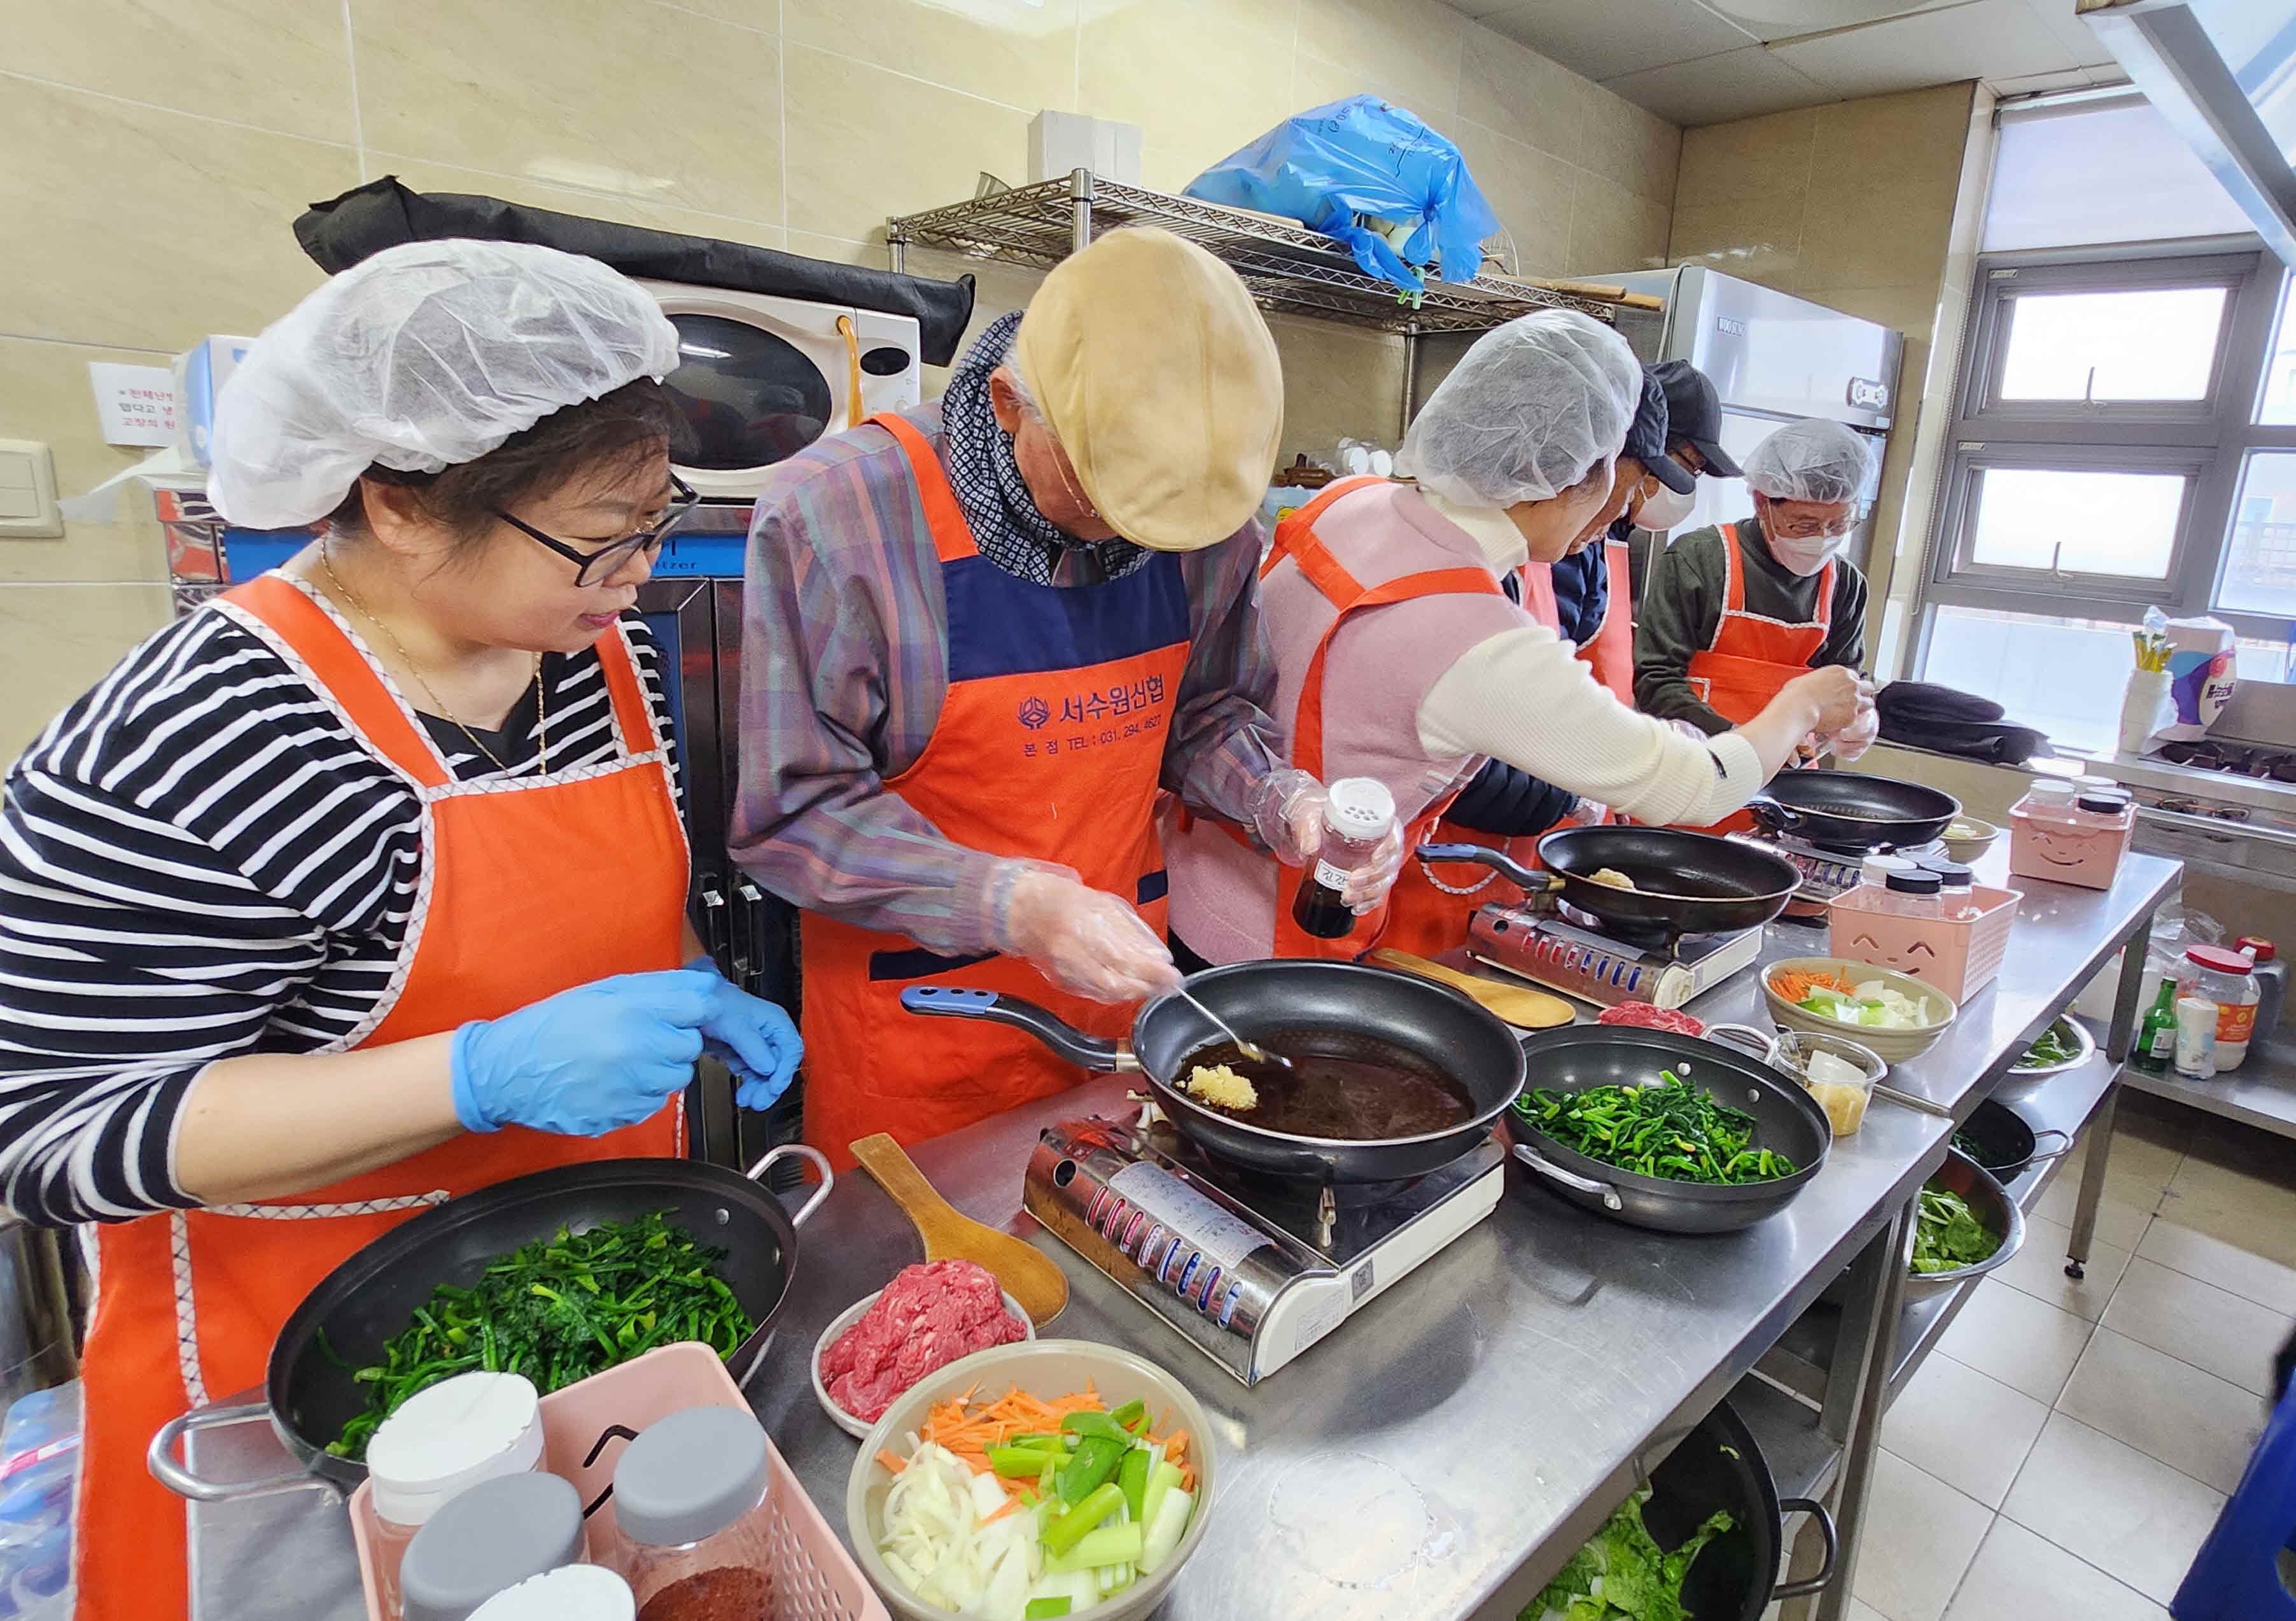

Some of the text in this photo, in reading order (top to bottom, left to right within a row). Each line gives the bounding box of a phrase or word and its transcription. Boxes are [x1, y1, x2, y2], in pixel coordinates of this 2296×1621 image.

[1060, 674, 1163, 723] 서수원신협
[1023, 743, 1037, 757] 본
[1046, 739, 1059, 755] 점
